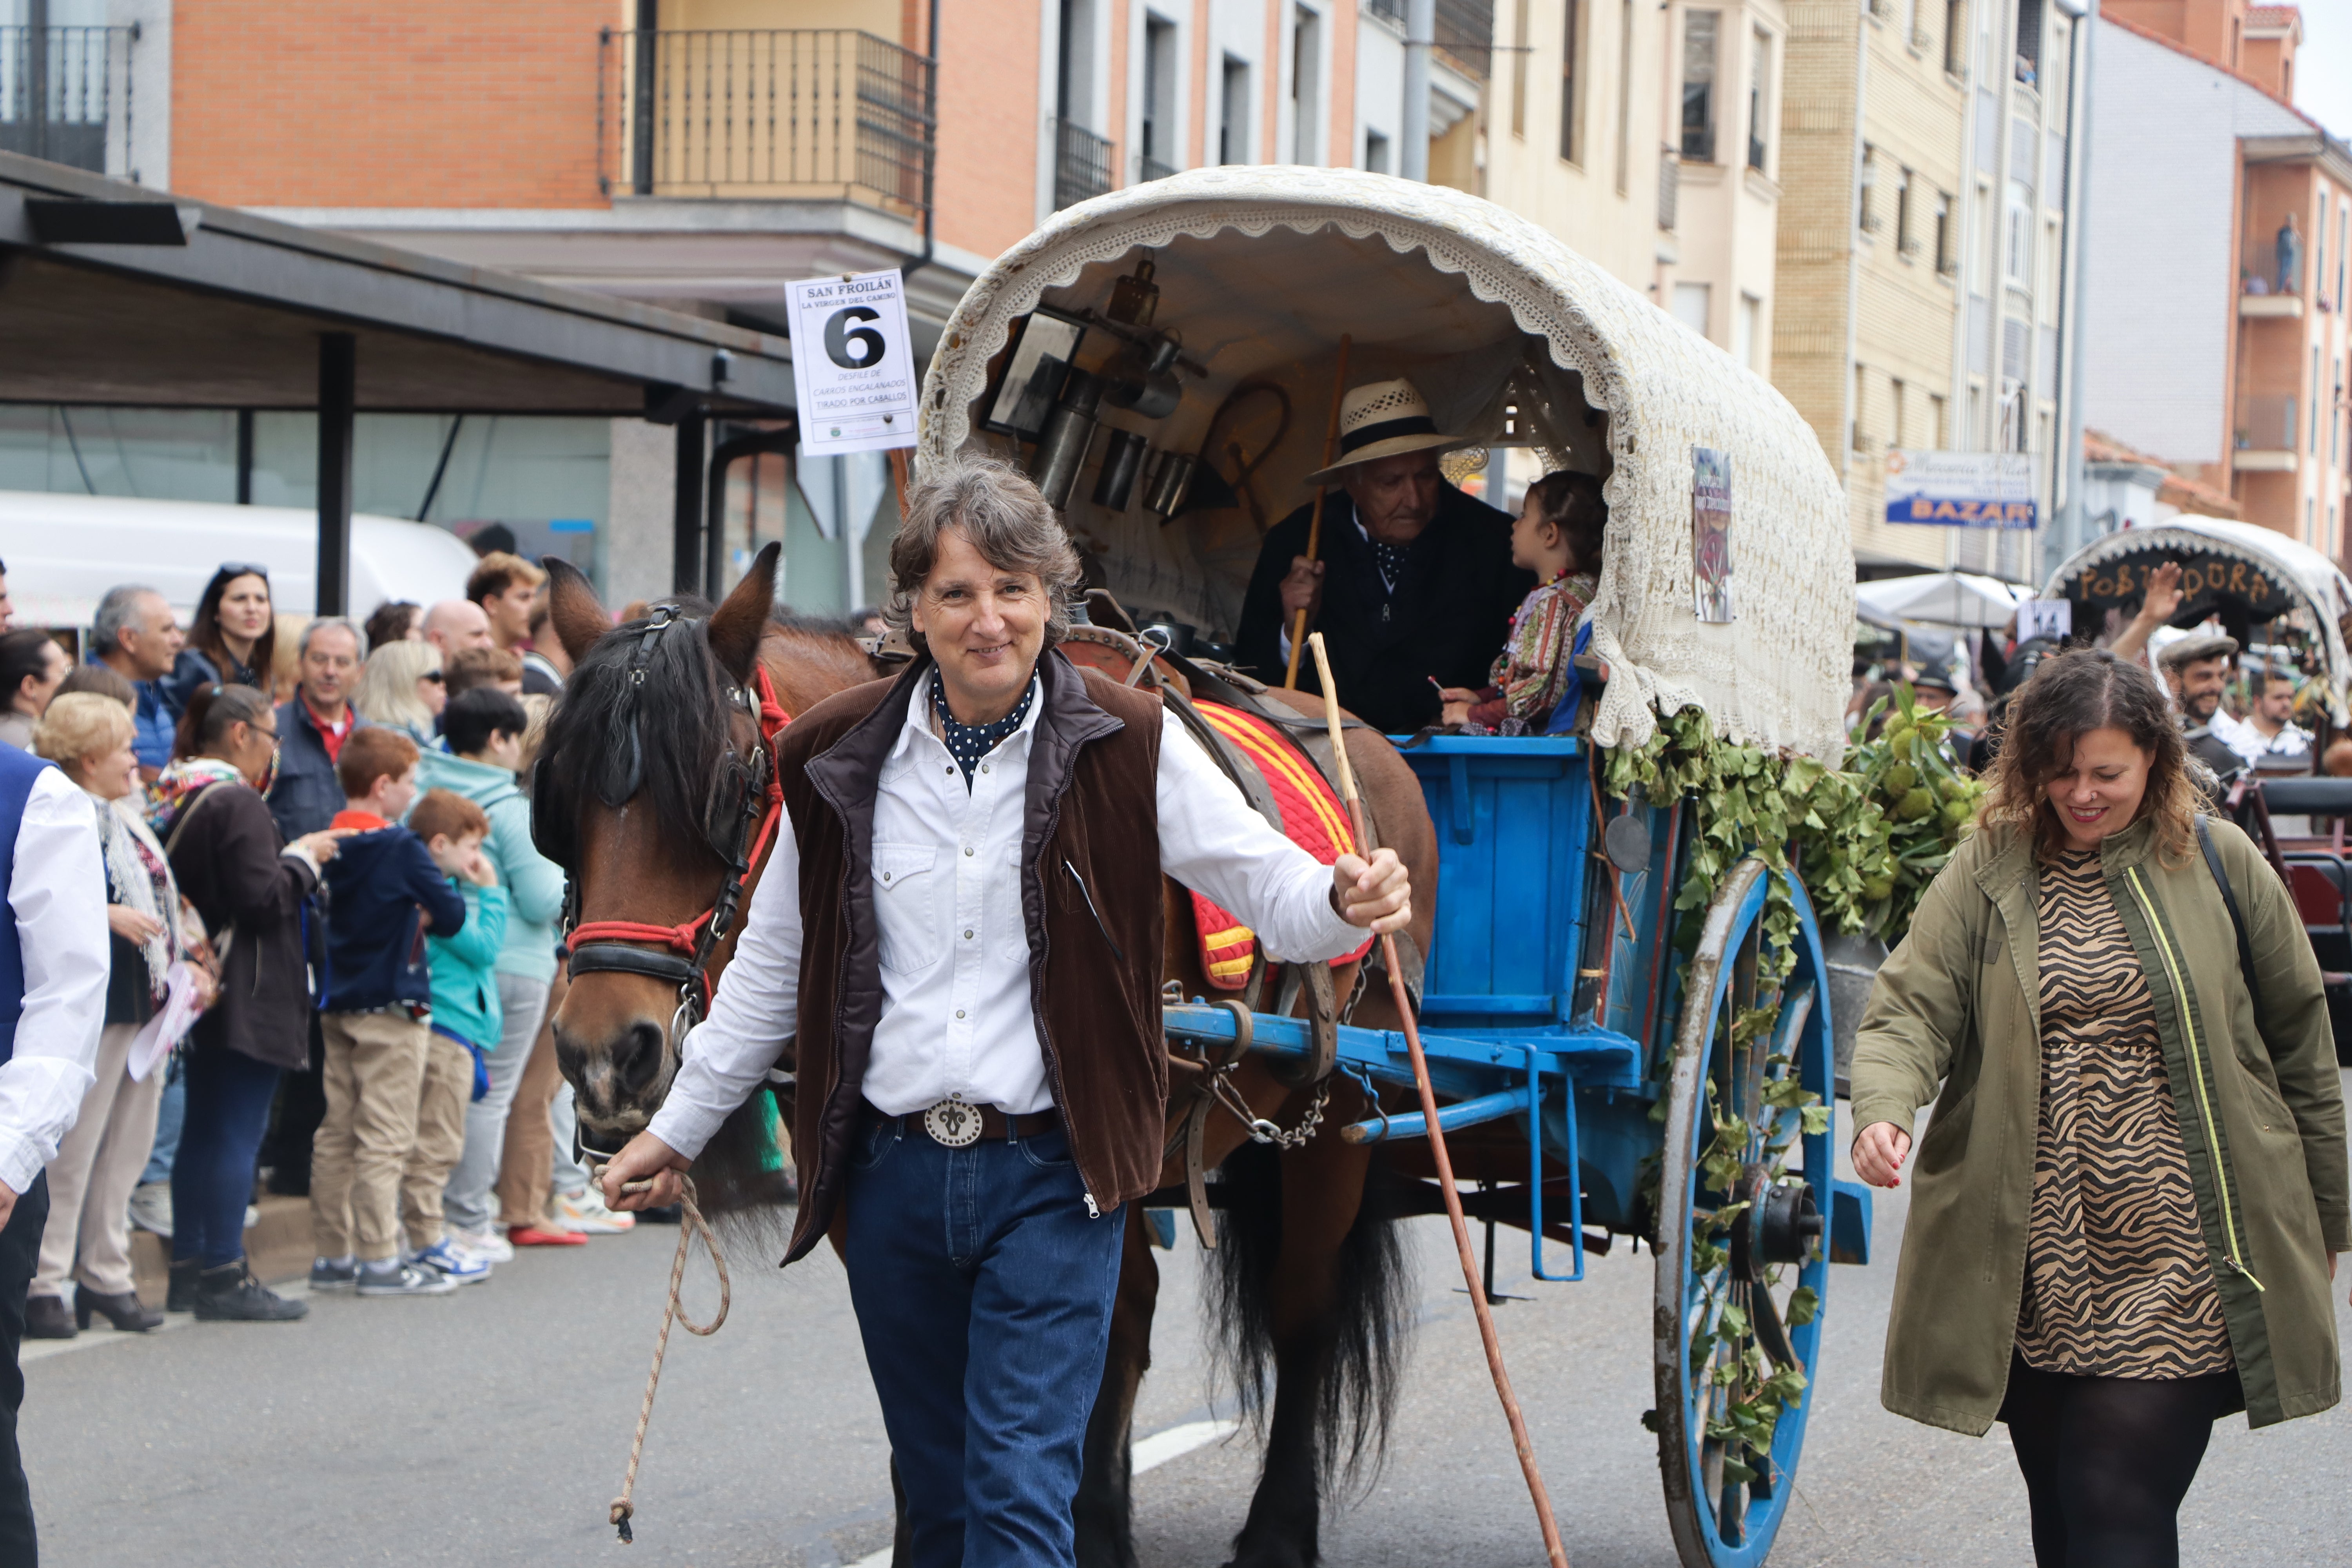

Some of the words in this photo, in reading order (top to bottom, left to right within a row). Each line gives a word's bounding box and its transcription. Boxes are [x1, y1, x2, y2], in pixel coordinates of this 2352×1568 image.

[807, 286, 833, 298] SAN
[838, 278, 892, 295] FROILÁN
[815, 298, 846, 307] VIRGEN
[866, 292, 896, 302] CAMINO
[824, 305, 886, 369] 6
[837, 370, 868, 381] DESFILE
[870, 369, 882, 377] DE
[813, 386, 846, 396] CARROS
[848, 379, 906, 393] ENGALANADOS
[816, 399, 847, 408] TIRADO
[849, 397, 866, 405] POR
[868, 392, 907, 403] CABALLOS
[1911, 499, 2029, 520] BAZAR
[2080, 562, 2269, 604] POBDURA
